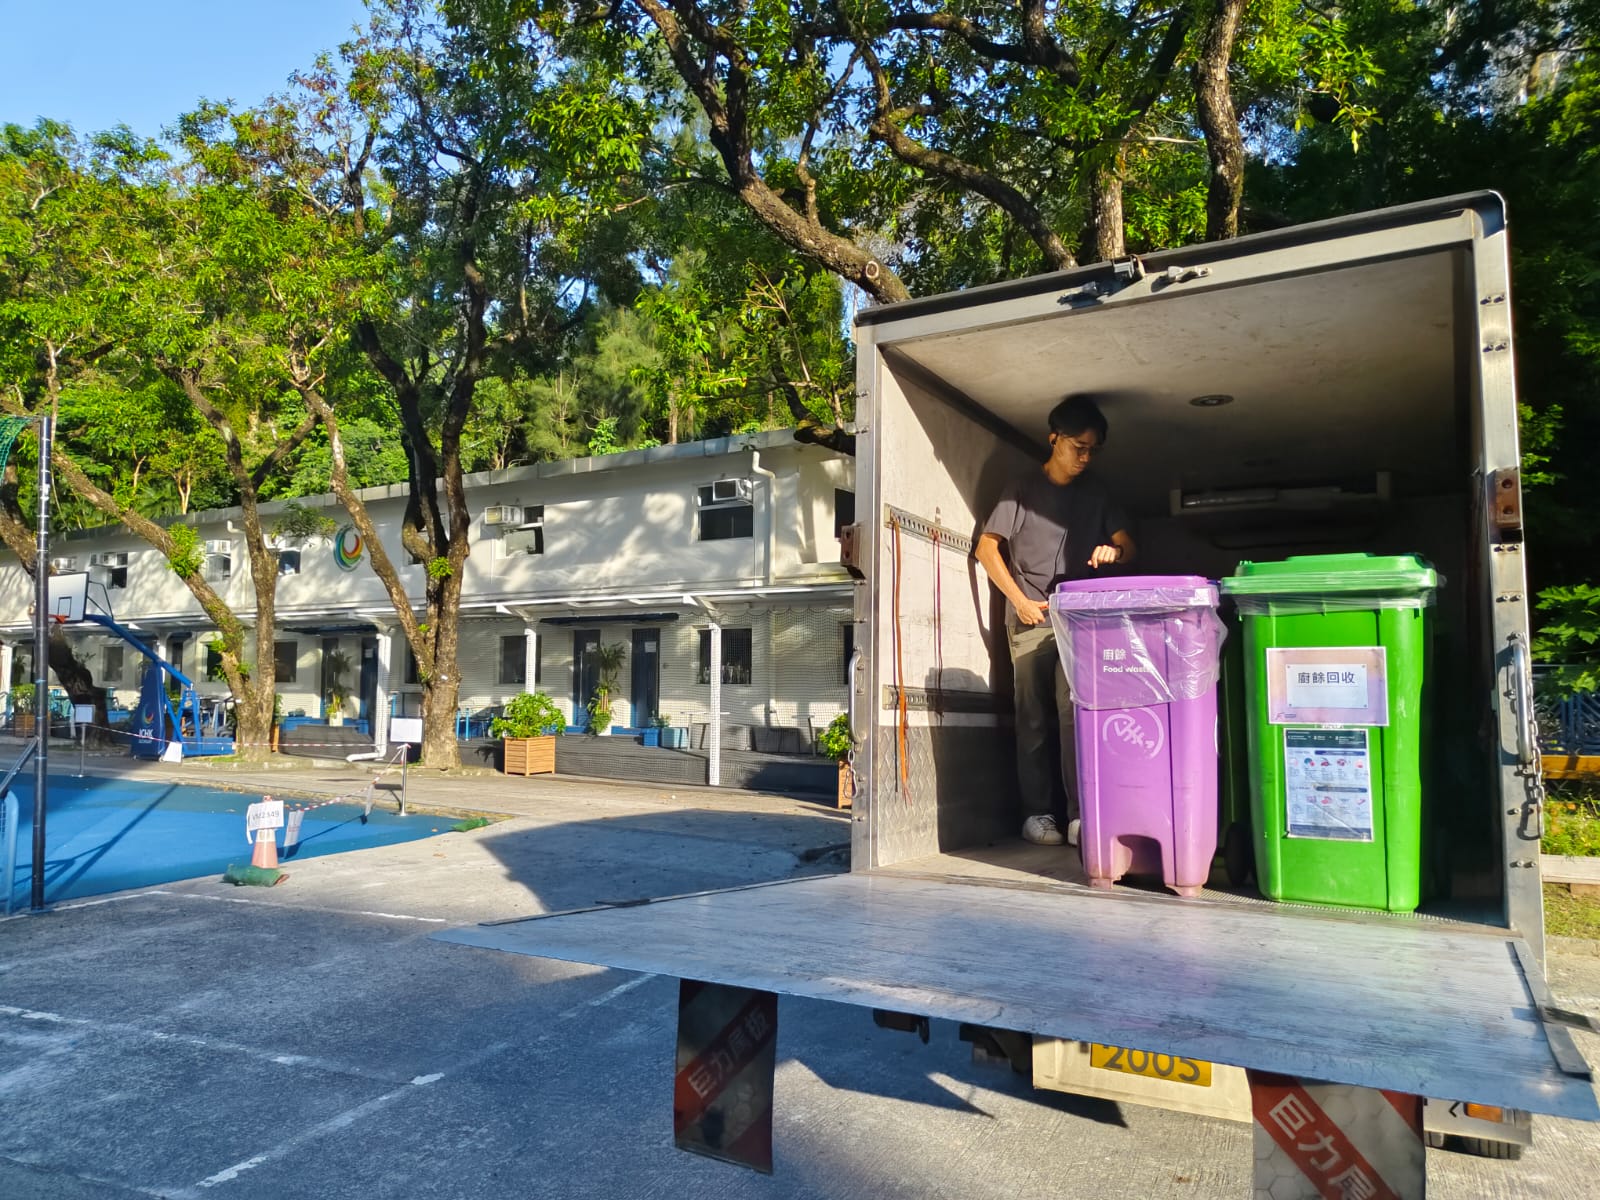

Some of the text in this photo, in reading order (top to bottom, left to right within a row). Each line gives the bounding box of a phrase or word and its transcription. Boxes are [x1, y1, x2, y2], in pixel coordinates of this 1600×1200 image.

[1103, 665, 1123, 673] Food
[1297, 671, 1355, 684] 廚餘回收
